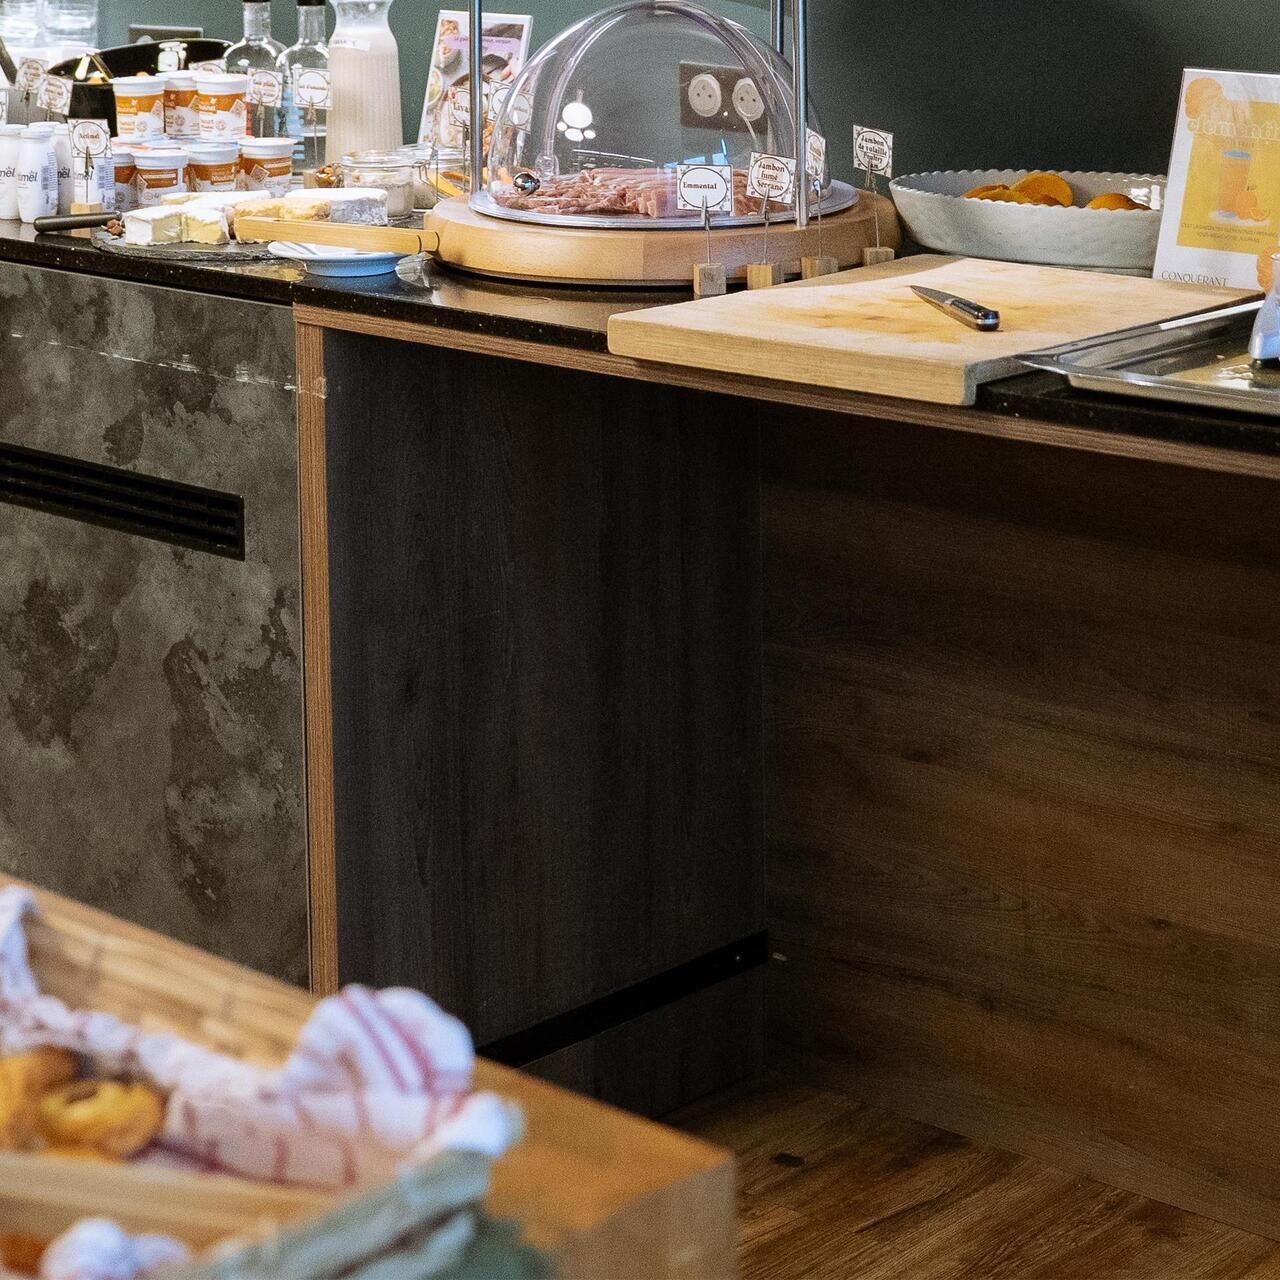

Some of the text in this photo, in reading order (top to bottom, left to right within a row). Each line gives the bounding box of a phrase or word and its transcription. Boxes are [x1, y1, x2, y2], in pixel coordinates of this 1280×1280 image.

[861, 135, 885, 146] Jambon
[759, 162, 785, 173] Jambon
[761, 171, 779, 180] fumé
[757, 180, 784, 191] Serrano
